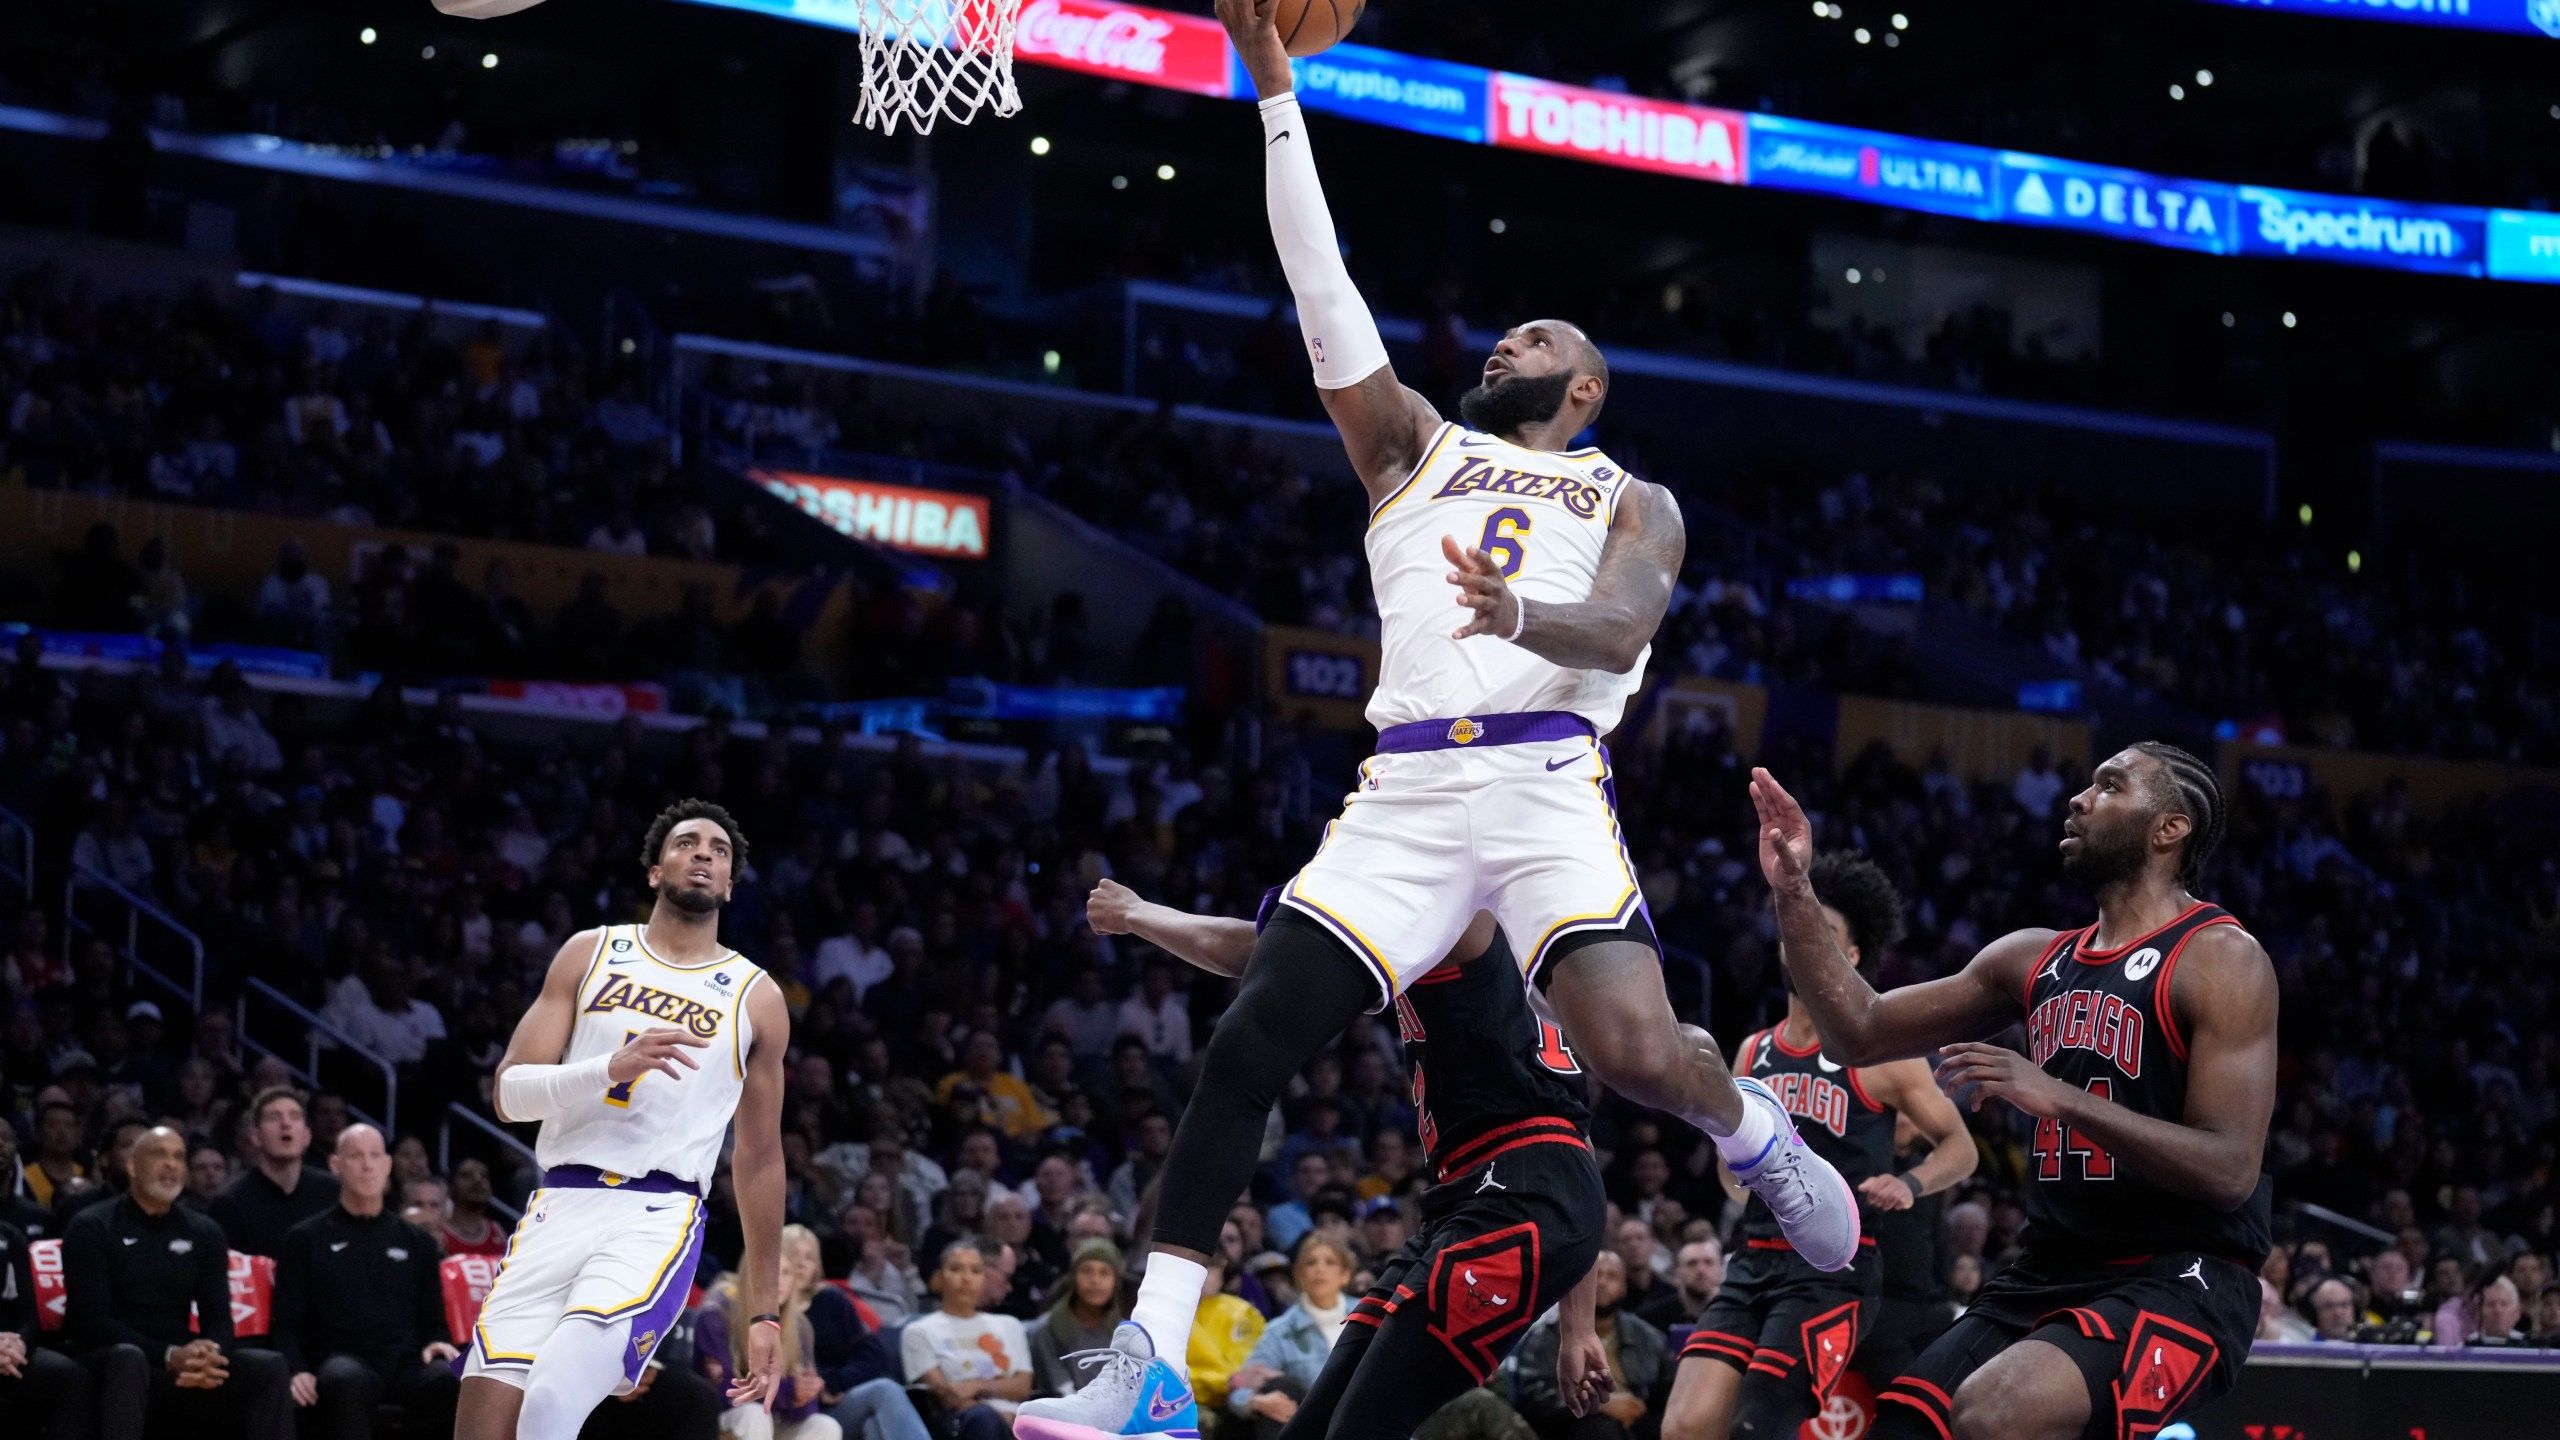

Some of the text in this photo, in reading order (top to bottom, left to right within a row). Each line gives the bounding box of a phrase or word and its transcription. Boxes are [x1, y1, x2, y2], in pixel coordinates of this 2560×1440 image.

[1307, 62, 1467, 115] crypto.com
[1499, 90, 1735, 171] TOSHIBA
[1881, 155, 1985, 198] ULTRA
[2064, 177, 2217, 235] DELTA
[2258, 196, 2453, 258] Spectrum
[1431, 456, 1602, 519] LAKERS
[1480, 505, 1533, 584] 6
[583, 973, 725, 1039] LAKERS
[704, 980, 733, 998] bibigo
[2028, 990, 2144, 1080] CHICAGO
